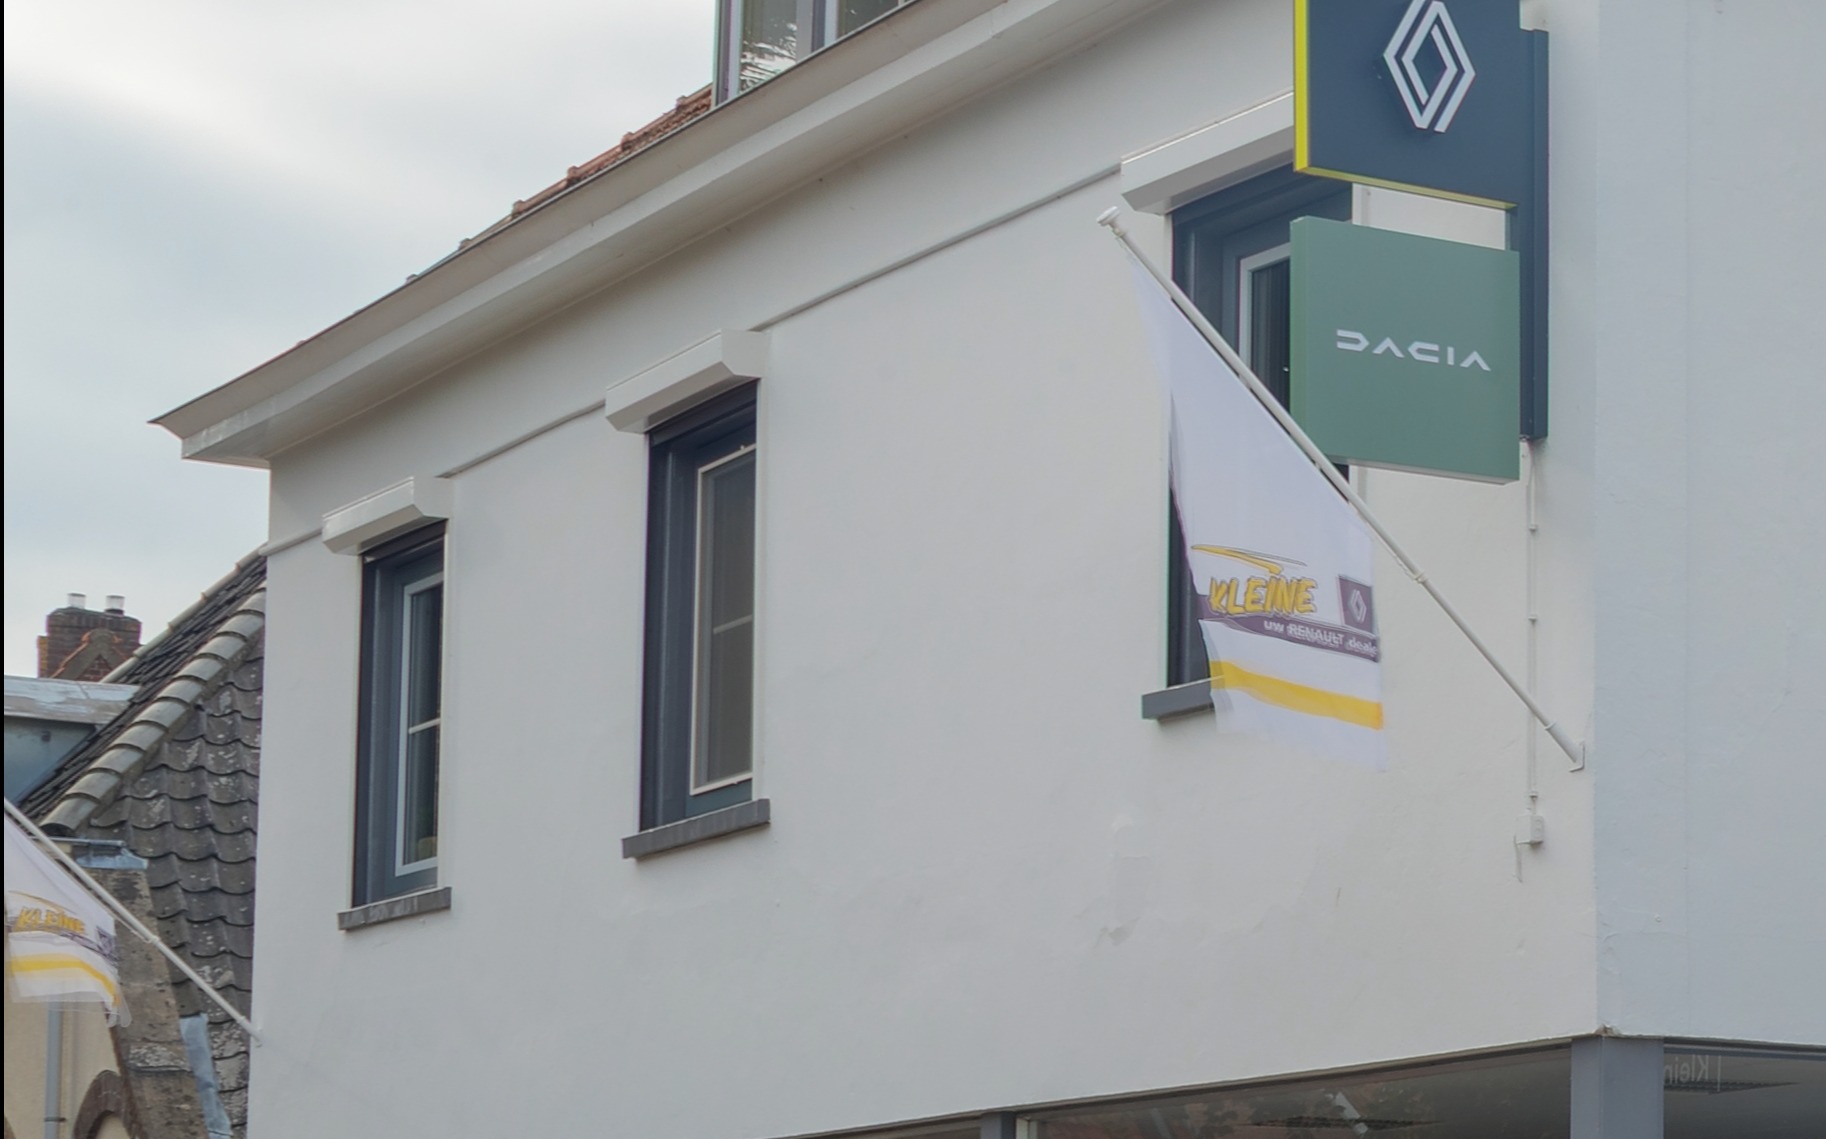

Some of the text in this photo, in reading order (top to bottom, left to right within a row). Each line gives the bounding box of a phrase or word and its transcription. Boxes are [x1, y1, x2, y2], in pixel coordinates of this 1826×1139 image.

[1336, 329, 1491, 372] DACIA
[1208, 575, 1319, 616] KLEINE
[1287, 624, 1346, 649] RENAULT
